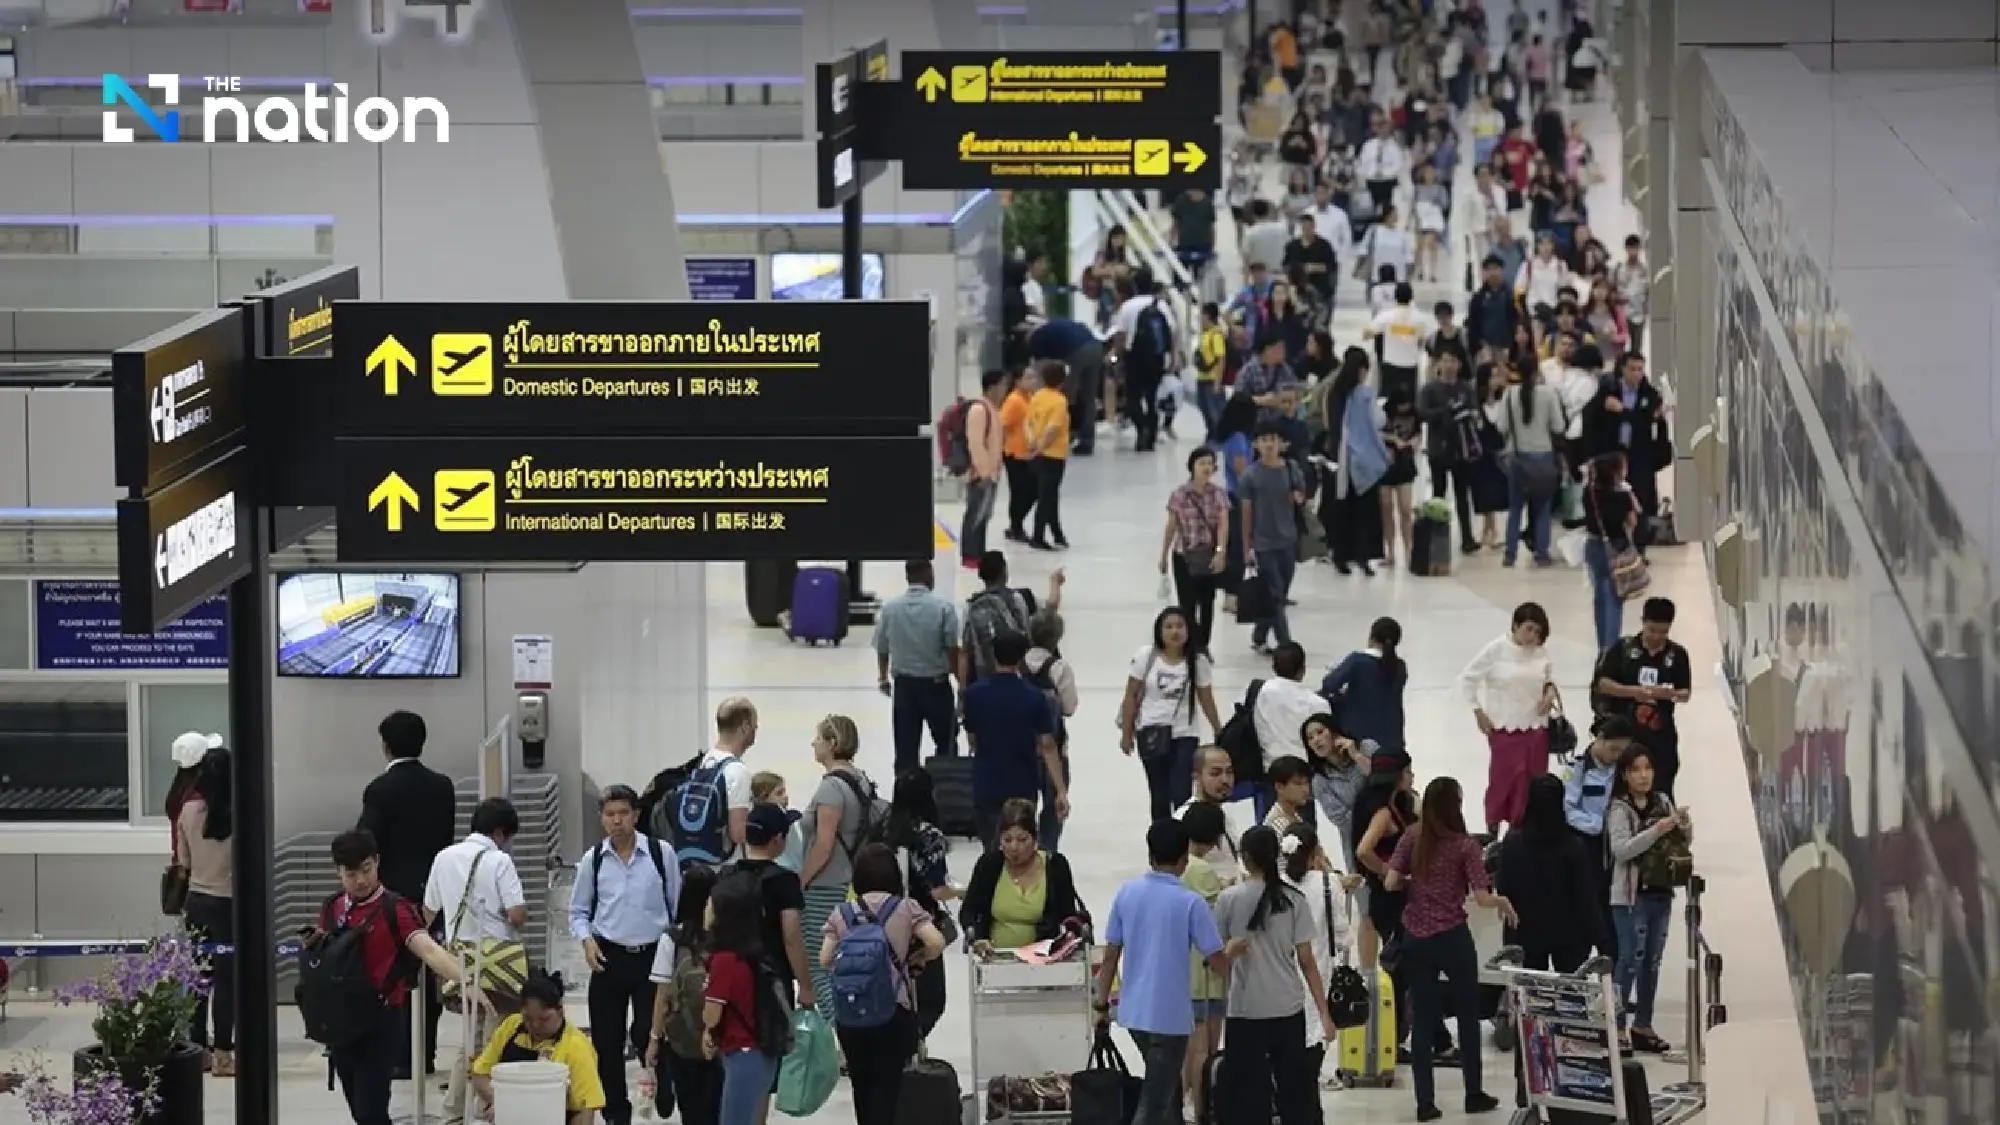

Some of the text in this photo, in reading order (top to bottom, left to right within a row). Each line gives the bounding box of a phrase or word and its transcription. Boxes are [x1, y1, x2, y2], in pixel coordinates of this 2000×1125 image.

[503, 319, 821, 363] ผู้โดยสารขาออกภายในประเทศ
[503, 377, 761, 399] Domestic Departures 国内出发
[505, 455, 830, 499] ผู้โดยสารขาออกระหว่างประเทศ
[505, 511, 787, 534] International Departures 国际出发
